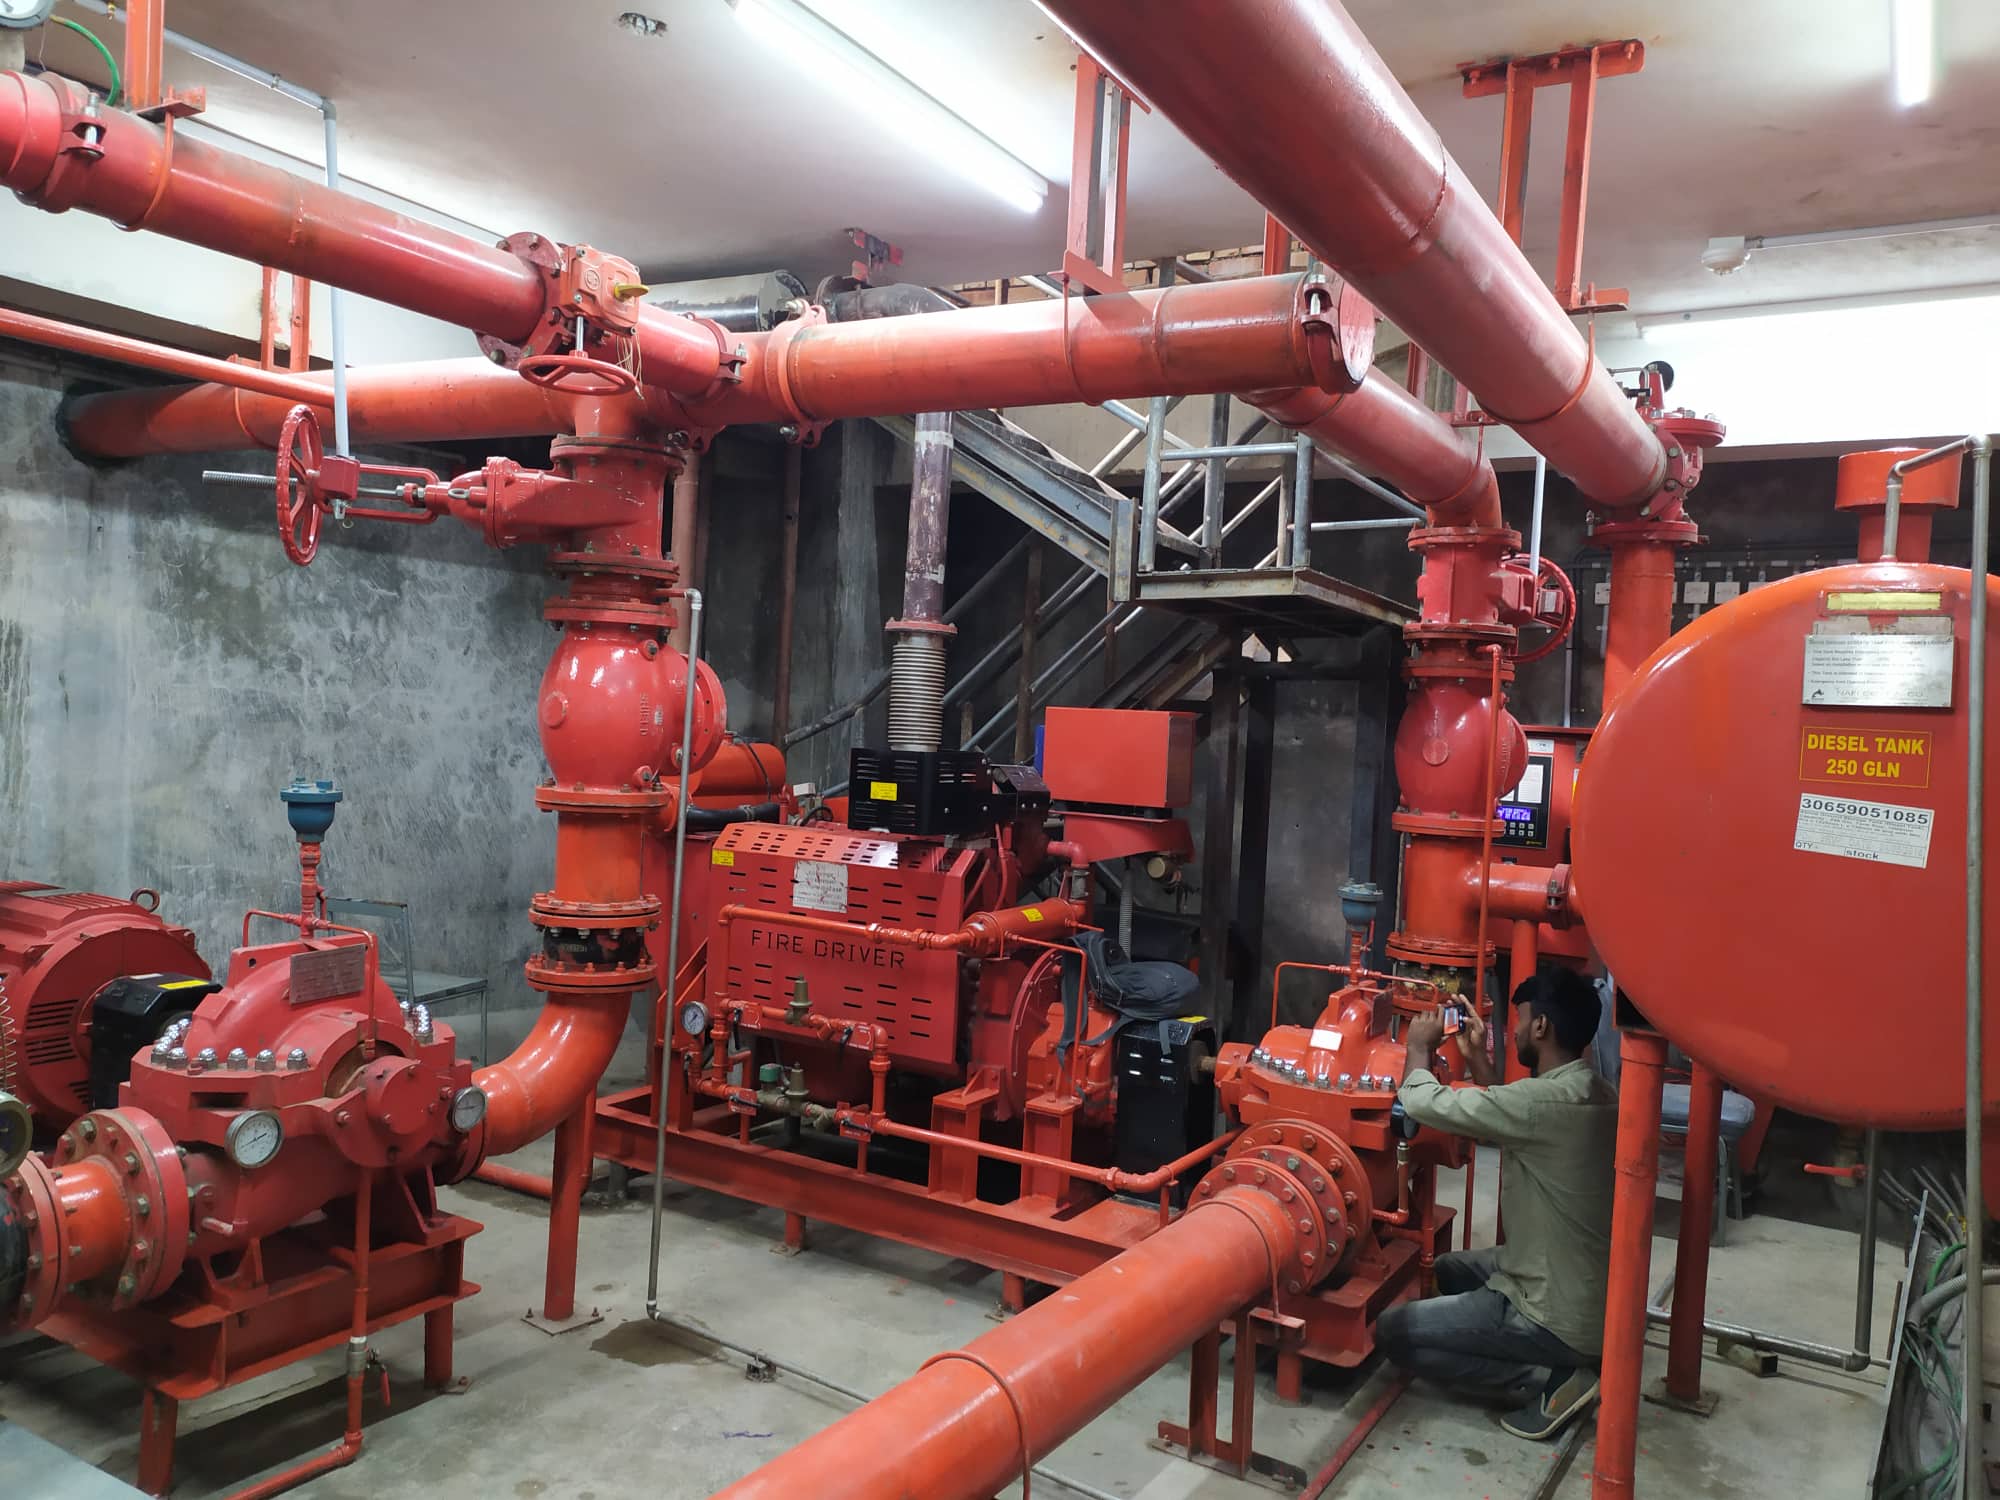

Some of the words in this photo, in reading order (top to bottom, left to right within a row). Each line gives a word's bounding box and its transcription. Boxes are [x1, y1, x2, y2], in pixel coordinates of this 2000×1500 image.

[1807, 734, 1869, 752] DIESEL
[1875, 737, 1924, 755] TANK
[1826, 759, 1858, 775] 250
[1863, 760, 1900, 778] GLN
[1801, 798, 1929, 825] 30659051085
[1846, 849, 1879, 860] stock
[751, 929, 804, 954] FIRE
[814, 939, 905, 969] DRIVER
